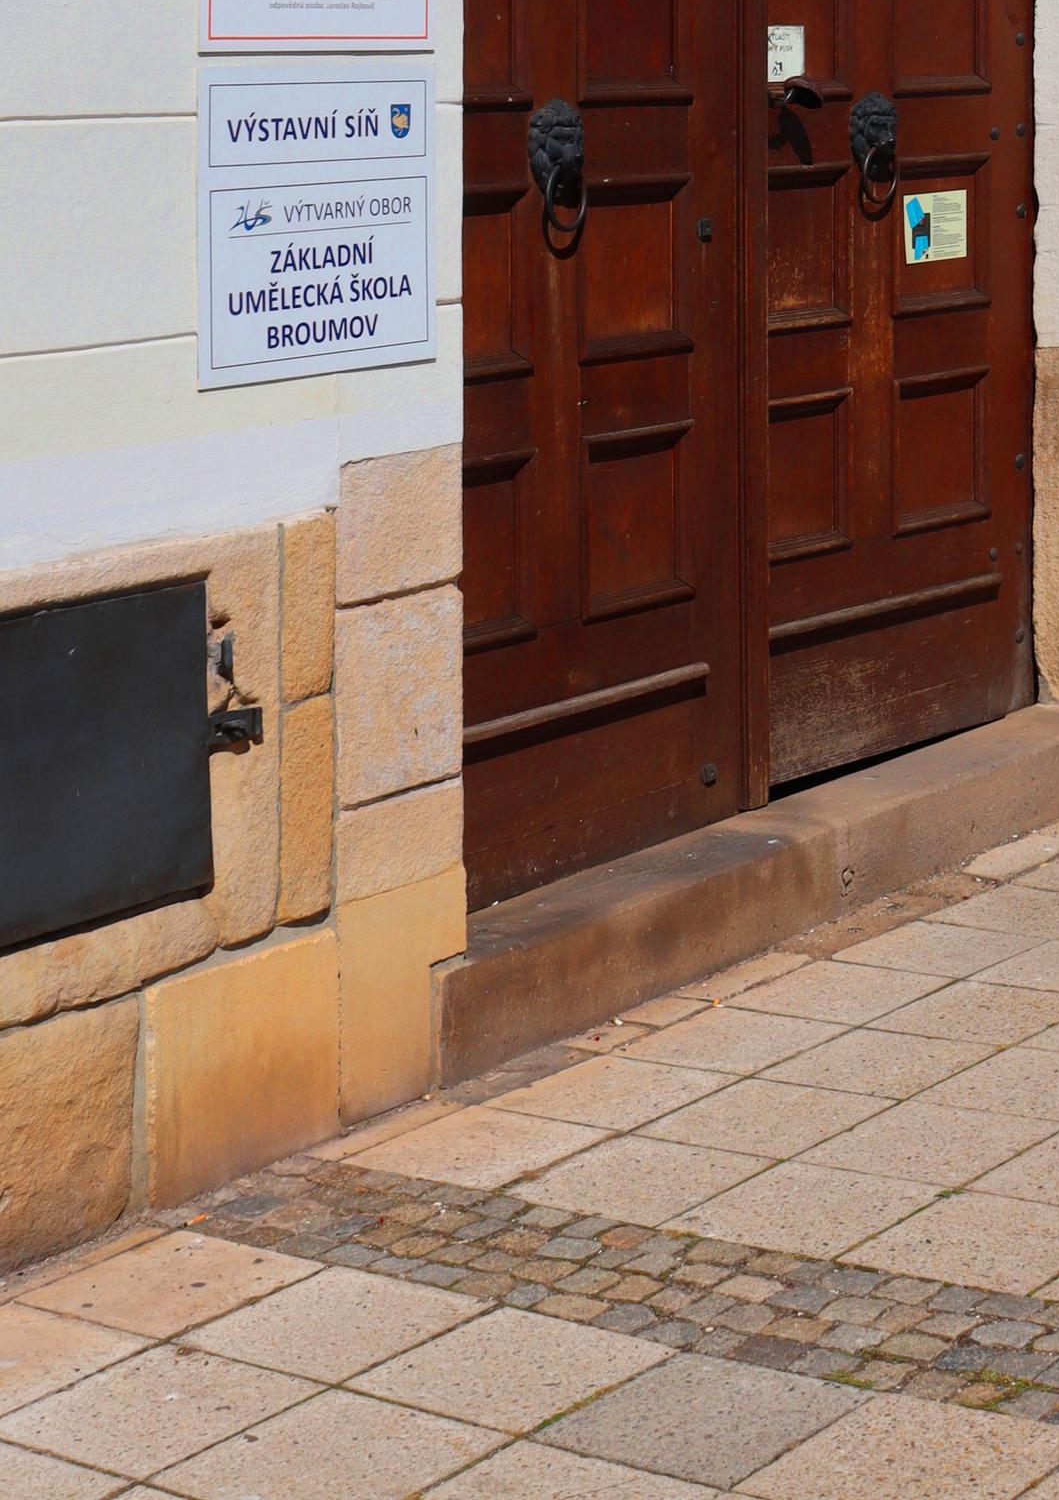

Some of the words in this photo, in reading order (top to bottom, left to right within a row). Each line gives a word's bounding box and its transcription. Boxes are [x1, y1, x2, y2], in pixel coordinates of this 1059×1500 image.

[227, 110, 338, 143] VÝSTAVNÍ
[344, 107, 379, 139] SÍŇ
[283, 196, 367, 223] VÝTVARNÝ
[369, 196, 412, 217] OBOR
[270, 235, 375, 274] ZÁKLADNÍ
[228, 275, 344, 316] UMĚLECKÁ
[349, 273, 412, 303] ŠKOLA
[267, 314, 378, 349] BROUMOV
